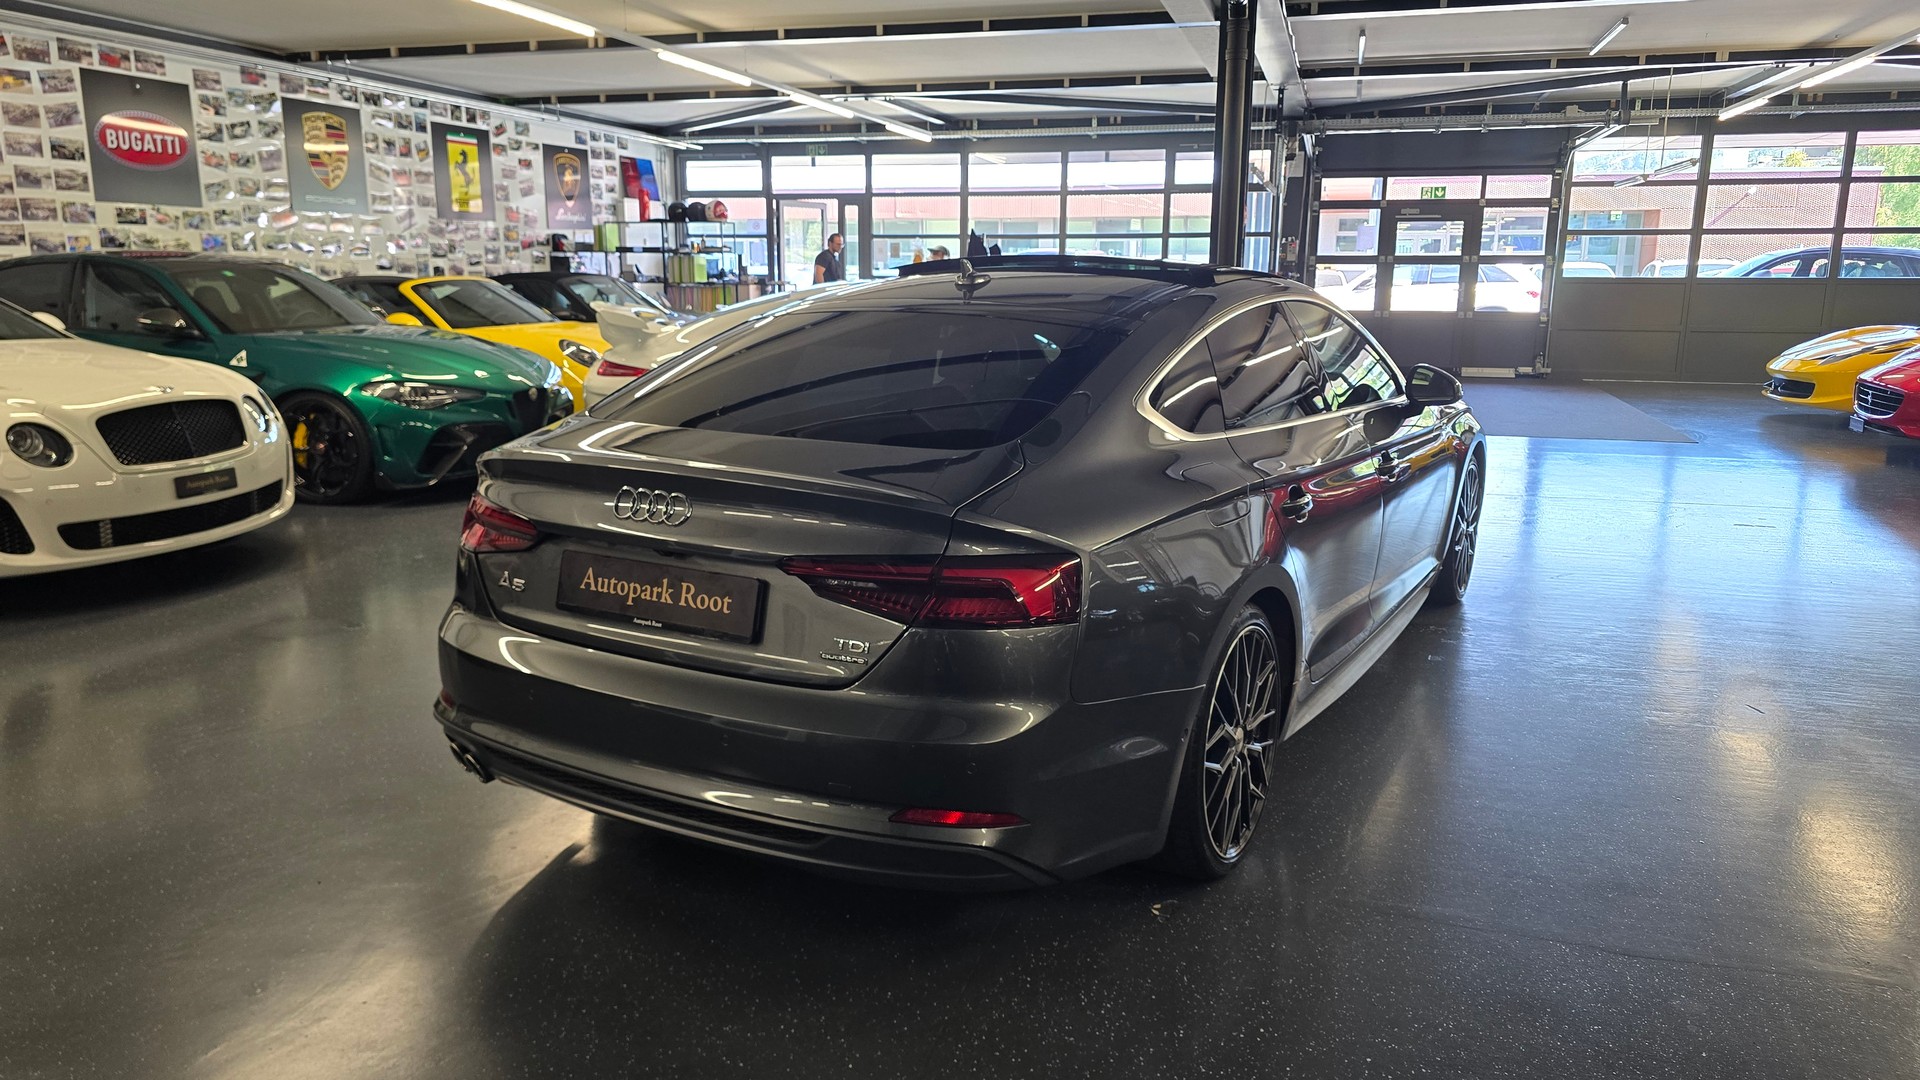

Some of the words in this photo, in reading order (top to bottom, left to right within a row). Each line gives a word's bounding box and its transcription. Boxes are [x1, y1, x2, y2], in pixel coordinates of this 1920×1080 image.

[105, 128, 181, 156] BUGATTI
[499, 570, 526, 592] A5
[579, 566, 674, 606] Autopark
[679, 582, 733, 614] Root
[633, 617, 651, 626] Autopark
[652, 620, 662, 628] Root
[833, 637, 870, 654] TDI
[820, 652, 868, 665] quattro
